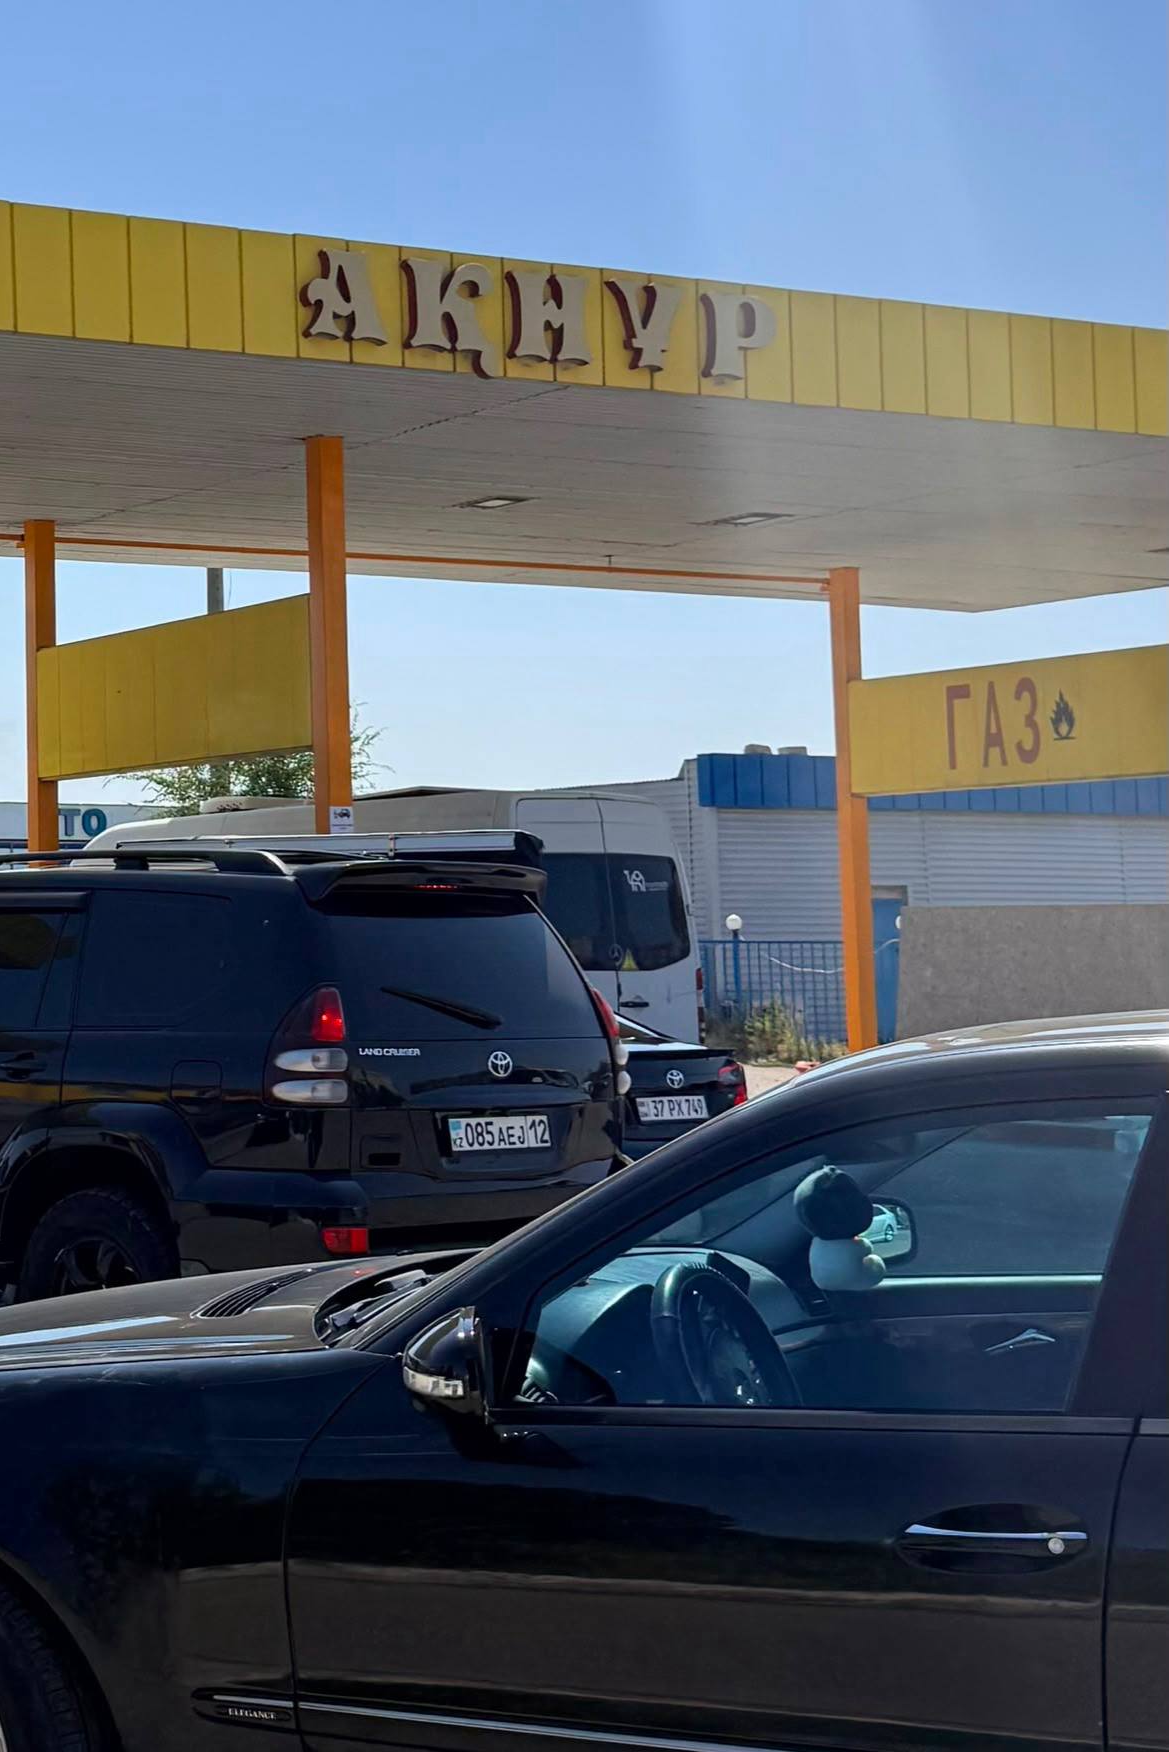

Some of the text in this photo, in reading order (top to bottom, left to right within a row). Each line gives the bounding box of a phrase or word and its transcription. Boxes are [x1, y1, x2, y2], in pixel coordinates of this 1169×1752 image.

[945, 676, 1041, 771] ГАЗ
[58, 808, 107, 837] ТО
[358, 1047, 421, 1056] LAND CRUISER
[528, 1118, 549, 1144] 12
